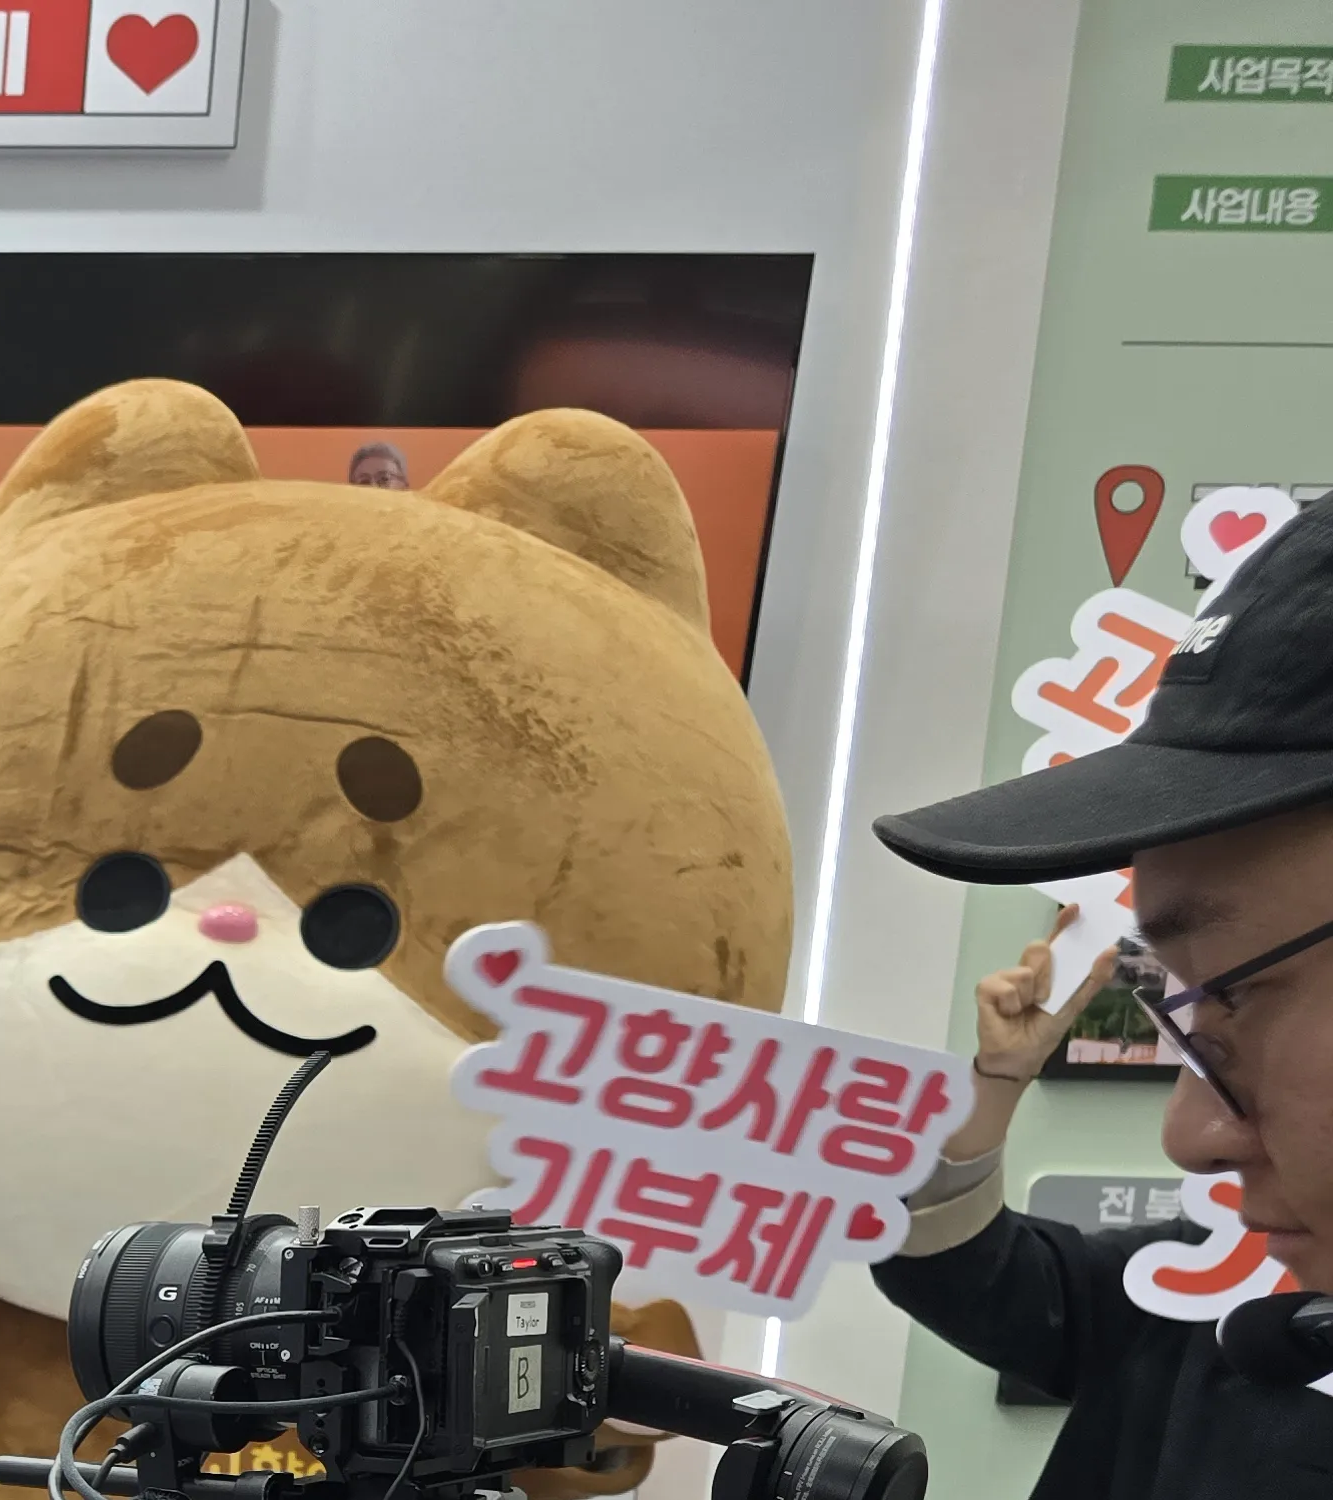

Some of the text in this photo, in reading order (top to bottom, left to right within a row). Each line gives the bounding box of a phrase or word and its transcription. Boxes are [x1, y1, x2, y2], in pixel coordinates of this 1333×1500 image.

[1198, 57, 1333, 95] 사업목적
[1181, 187, 1321, 225] 사업내용
[475, 984, 952, 1177] 고향사랑
[512, 1134, 835, 1300] 기부제
[246, 1263, 257, 1273] 70
[158, 1286, 178, 1301] G
[515, 1316, 540, 1332] Taylor
[517, 1357, 530, 1400] B
